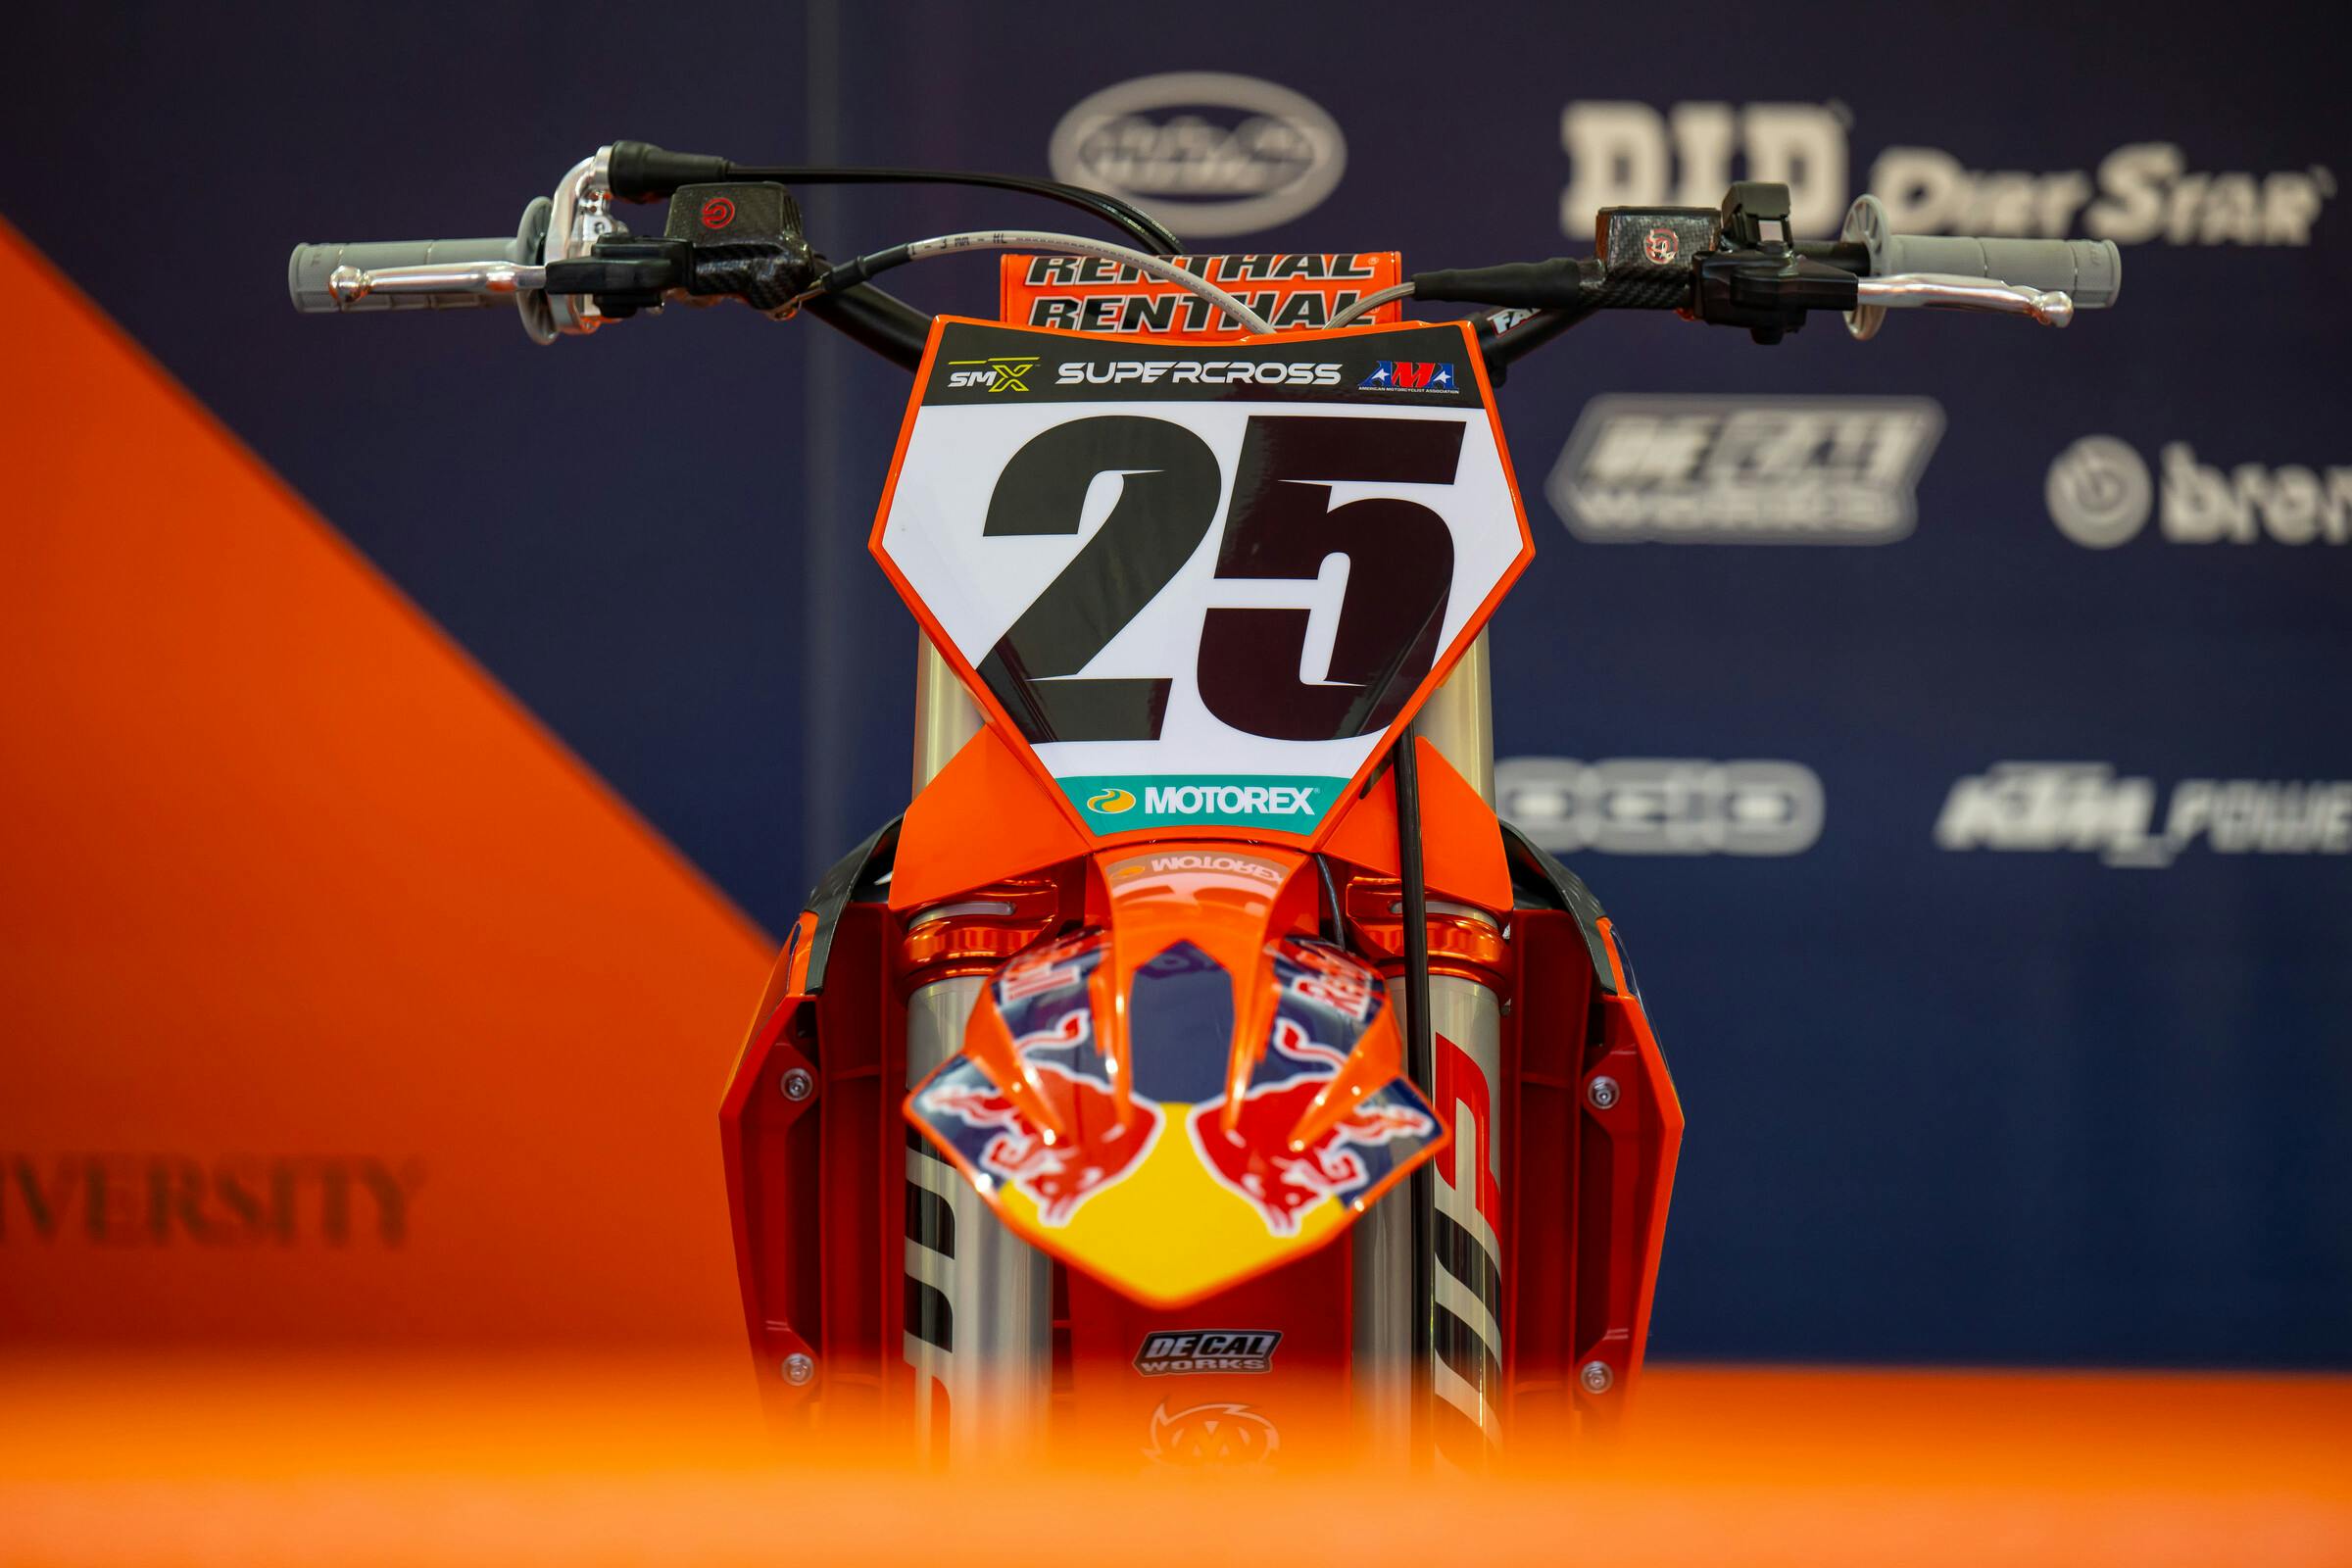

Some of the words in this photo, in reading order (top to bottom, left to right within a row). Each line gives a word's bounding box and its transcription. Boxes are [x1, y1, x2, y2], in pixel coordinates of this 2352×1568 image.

[1562, 101, 1848, 241] DID
[1025, 254, 1376, 287] RENTHAL
[1029, 289, 1377, 333] RENTHAL
[947, 361, 1034, 393] SMX
[1054, 361, 1343, 386] SUPERCROSS
[1357, 360, 1458, 389] AMA
[975, 414, 1467, 742] 25
[1145, 786, 1315, 815] MOTOREX
[0, 1151, 428, 1250] VERSITY
[1145, 1335, 1275, 1360] DECAL
[1141, 1358, 1265, 1372] WORKS
